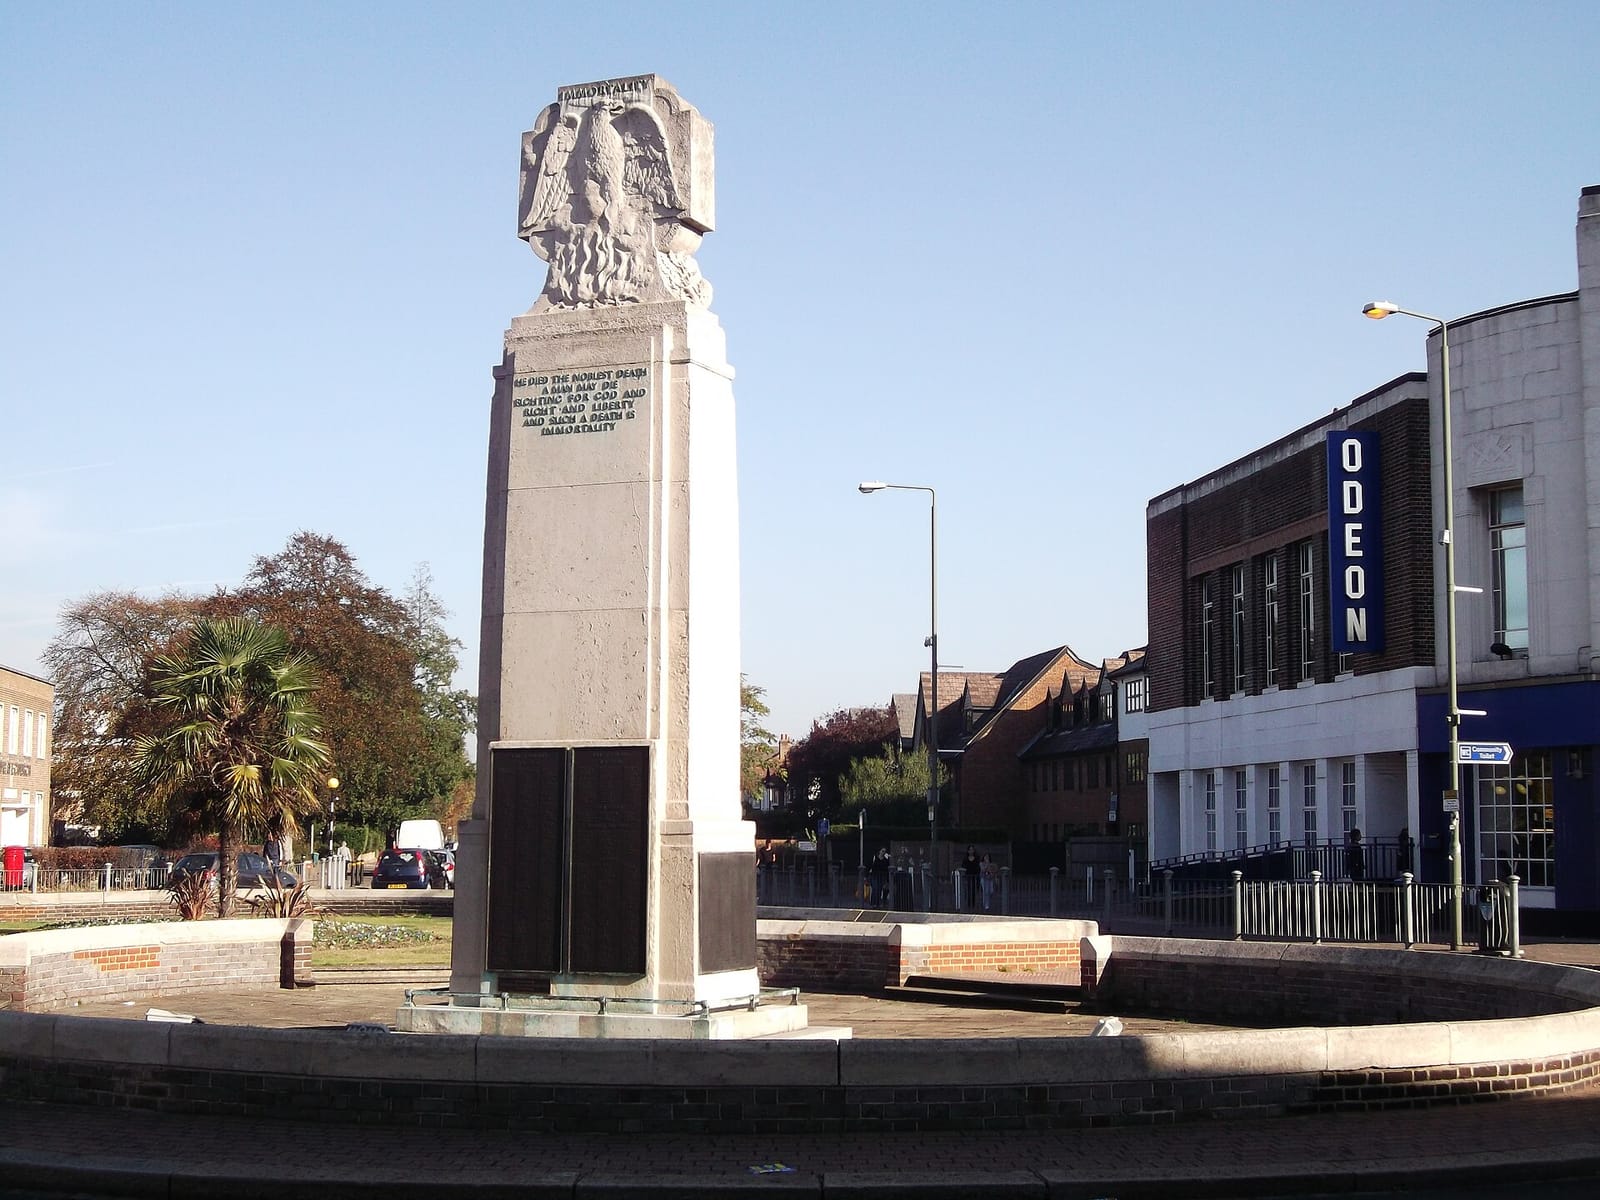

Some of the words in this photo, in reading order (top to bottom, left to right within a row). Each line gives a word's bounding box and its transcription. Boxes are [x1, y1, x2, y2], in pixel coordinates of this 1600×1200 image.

[514, 377, 527, 387] HE
[527, 376, 548, 386] DIED
[551, 374, 570, 384] THE
[572, 370, 613, 382] NOBLEST
[615, 368, 647, 380] DEATH
[542, 386, 549, 395] A
[550, 384, 573, 394] MAN
[576, 382, 597, 392] MAY
[602, 380, 618, 390] DIE
[567, 393, 590, 403] FOR
[593, 391, 618, 401] GOD
[622, 388, 646, 399] AND
[561, 403, 586, 414] AND
[592, 400, 635, 412] LIBERTY
[522, 416, 545, 427] AND
[548, 415, 576, 425] SUCH
[580, 414, 587, 423] A
[590, 411, 623, 422] DEATH
[625, 410, 635, 419] IS
[541, 422, 616, 436] IMMORTALITY
[1342, 438, 1367, 642] ODEON
